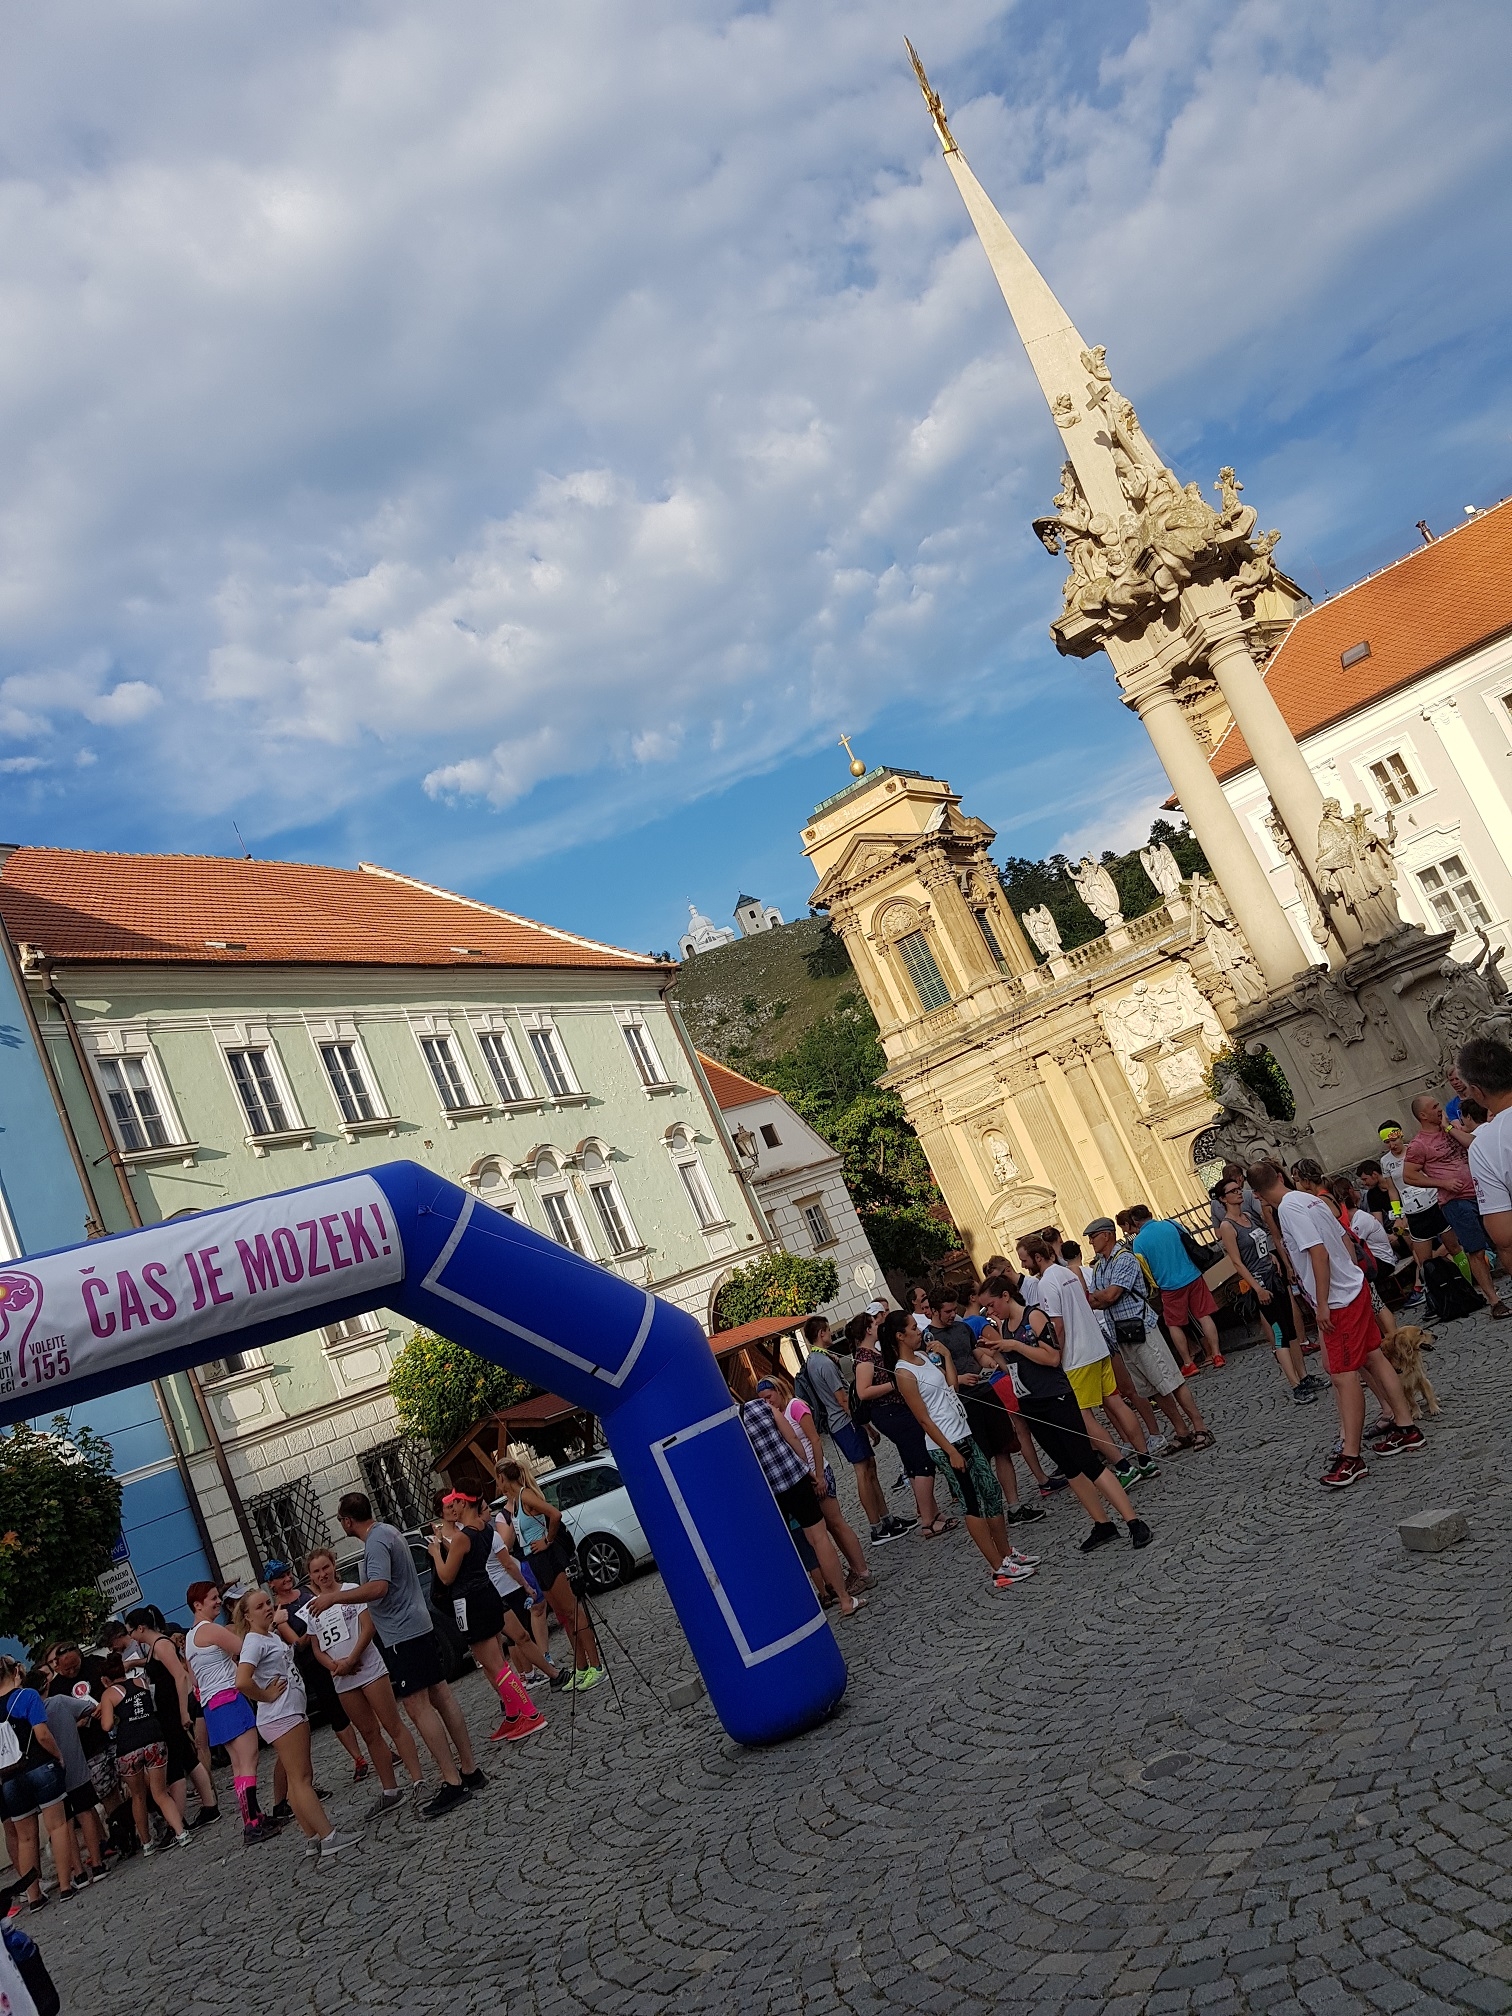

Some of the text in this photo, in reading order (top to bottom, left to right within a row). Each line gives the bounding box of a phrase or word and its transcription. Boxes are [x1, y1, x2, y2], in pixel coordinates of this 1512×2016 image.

[1413, 1198, 1424, 1209] 1
[78, 1203, 392, 1339] ČAS JE MOZEK!
[29, 1335, 67, 1355] VOLEJTE
[32, 1349, 71, 1383] 155
[322, 1626, 341, 1647] 55
